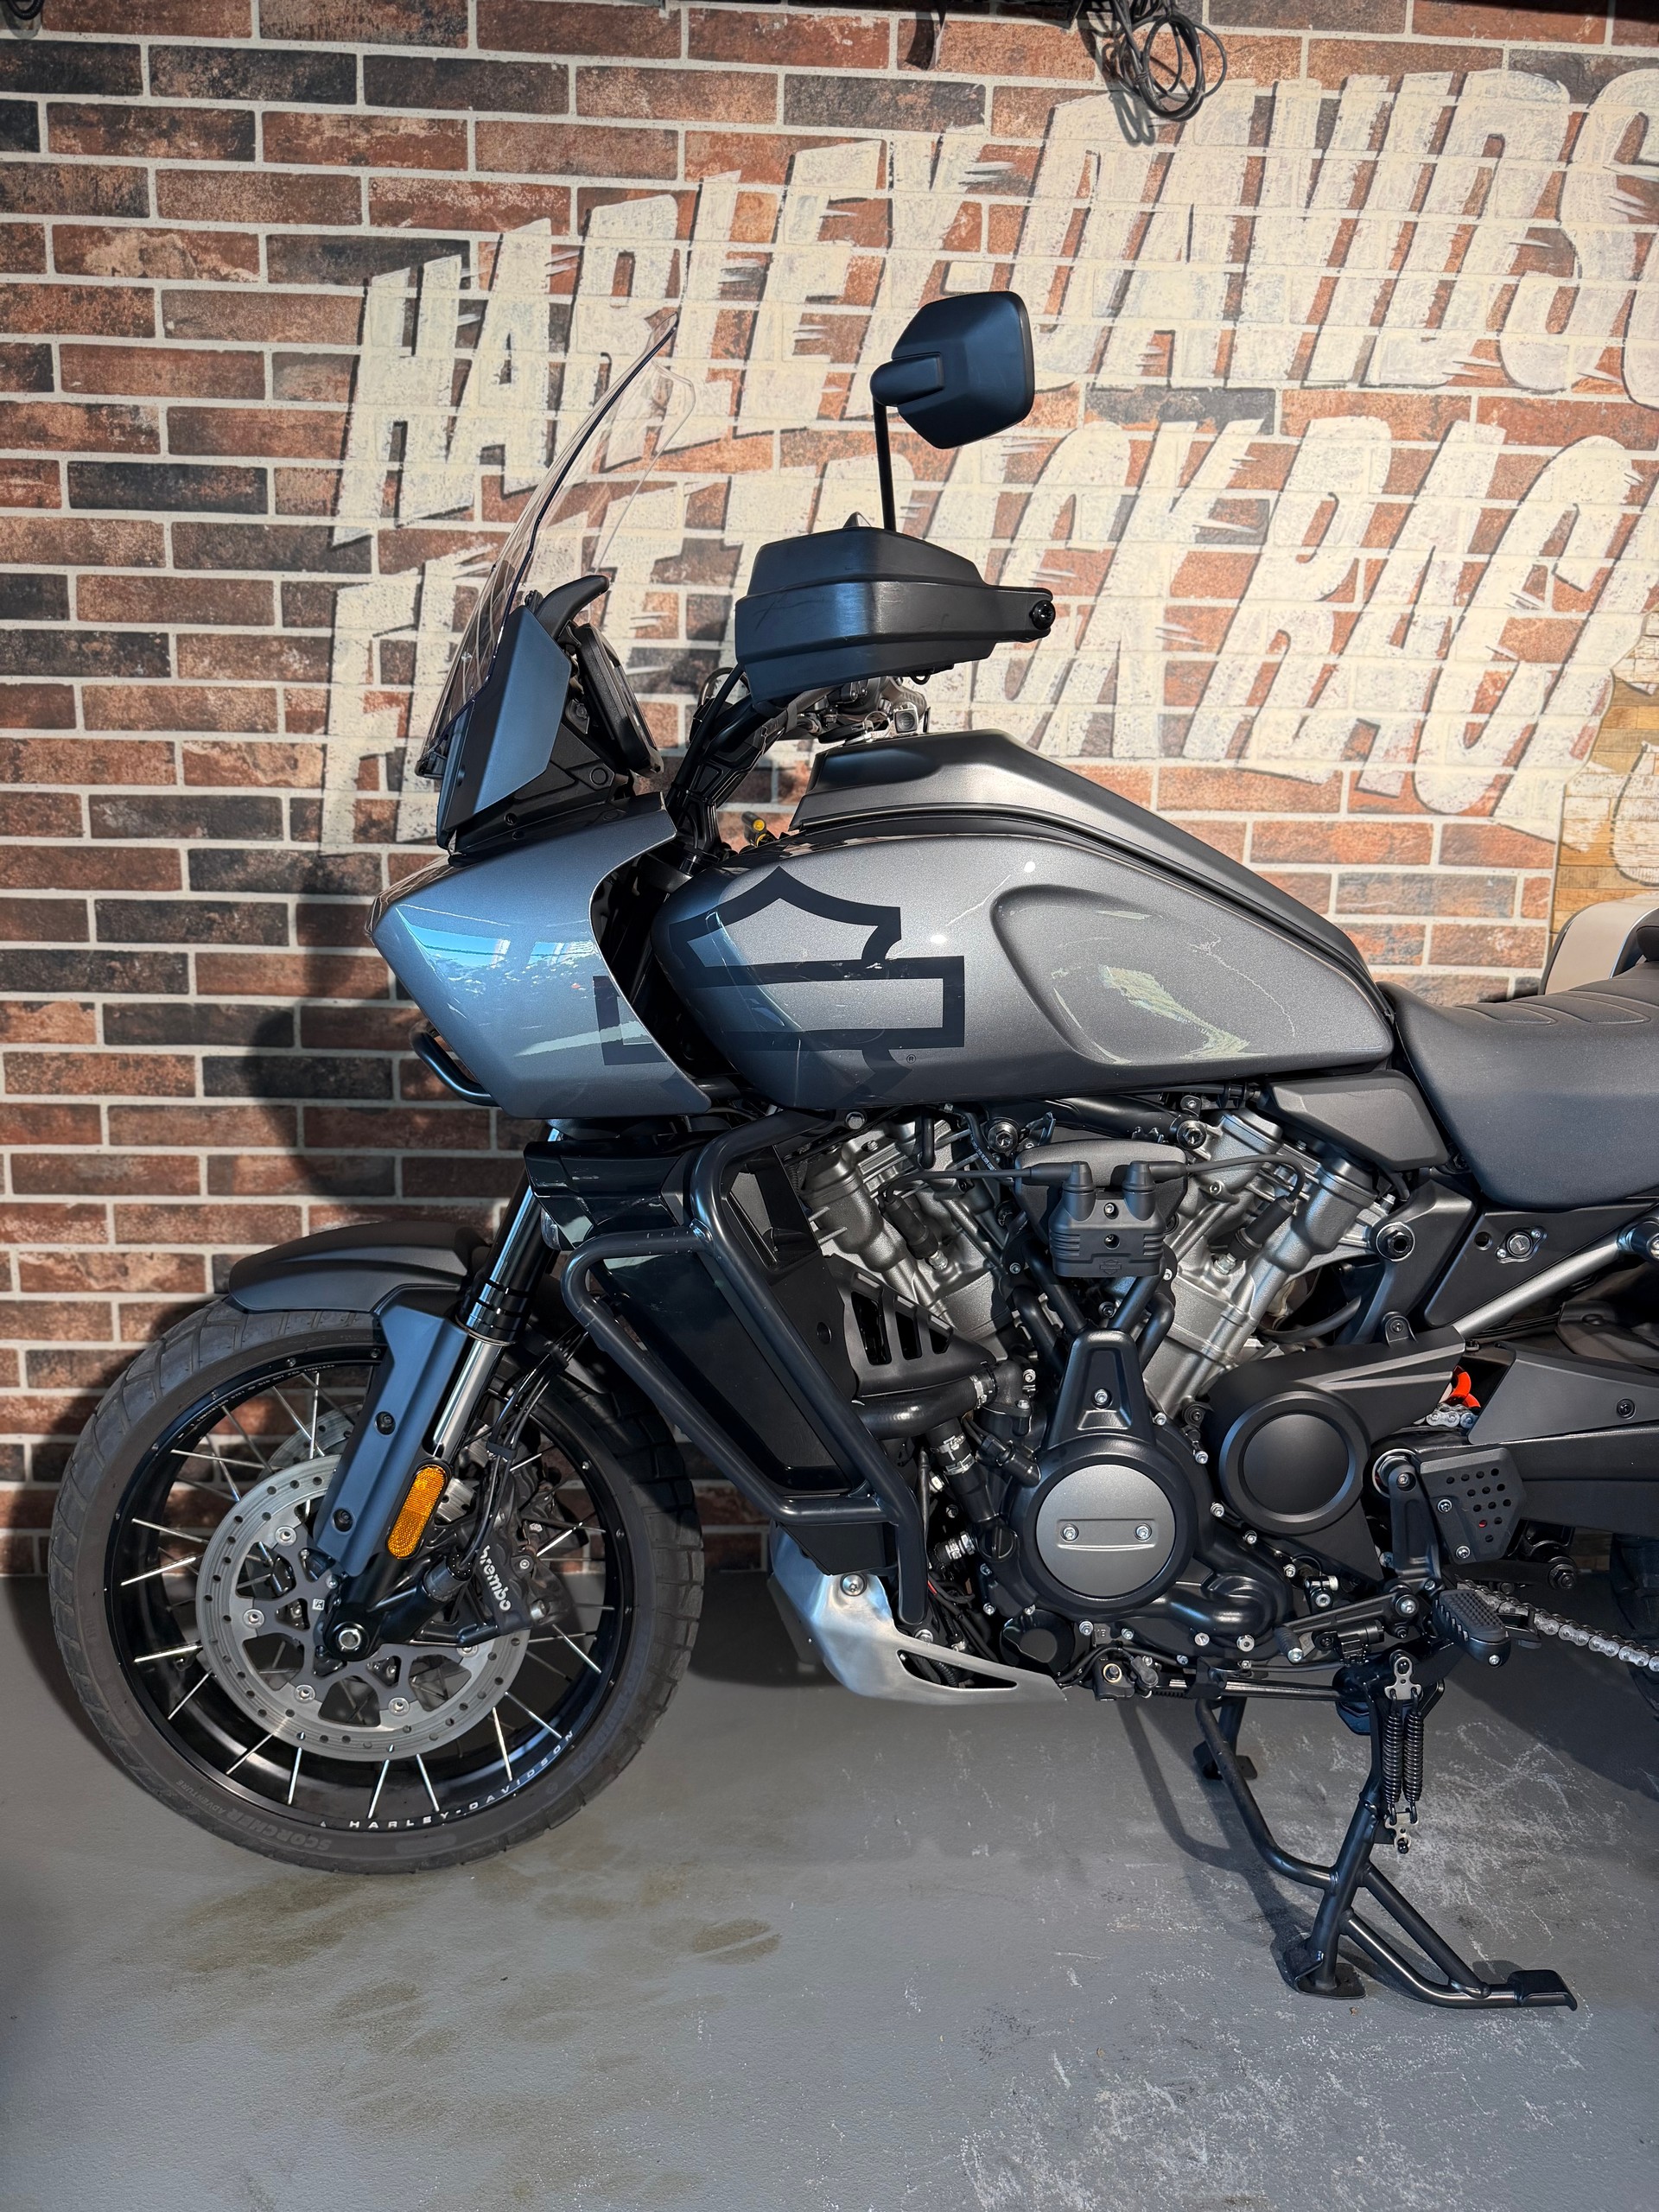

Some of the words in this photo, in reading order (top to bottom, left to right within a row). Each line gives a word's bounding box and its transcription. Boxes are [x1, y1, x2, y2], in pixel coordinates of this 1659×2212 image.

[480, 1545, 512, 1611] brembo
[349, 1730, 574, 1830] HARLEY-DAVIDSON
[227, 1808, 333, 1851] SCORCHER
